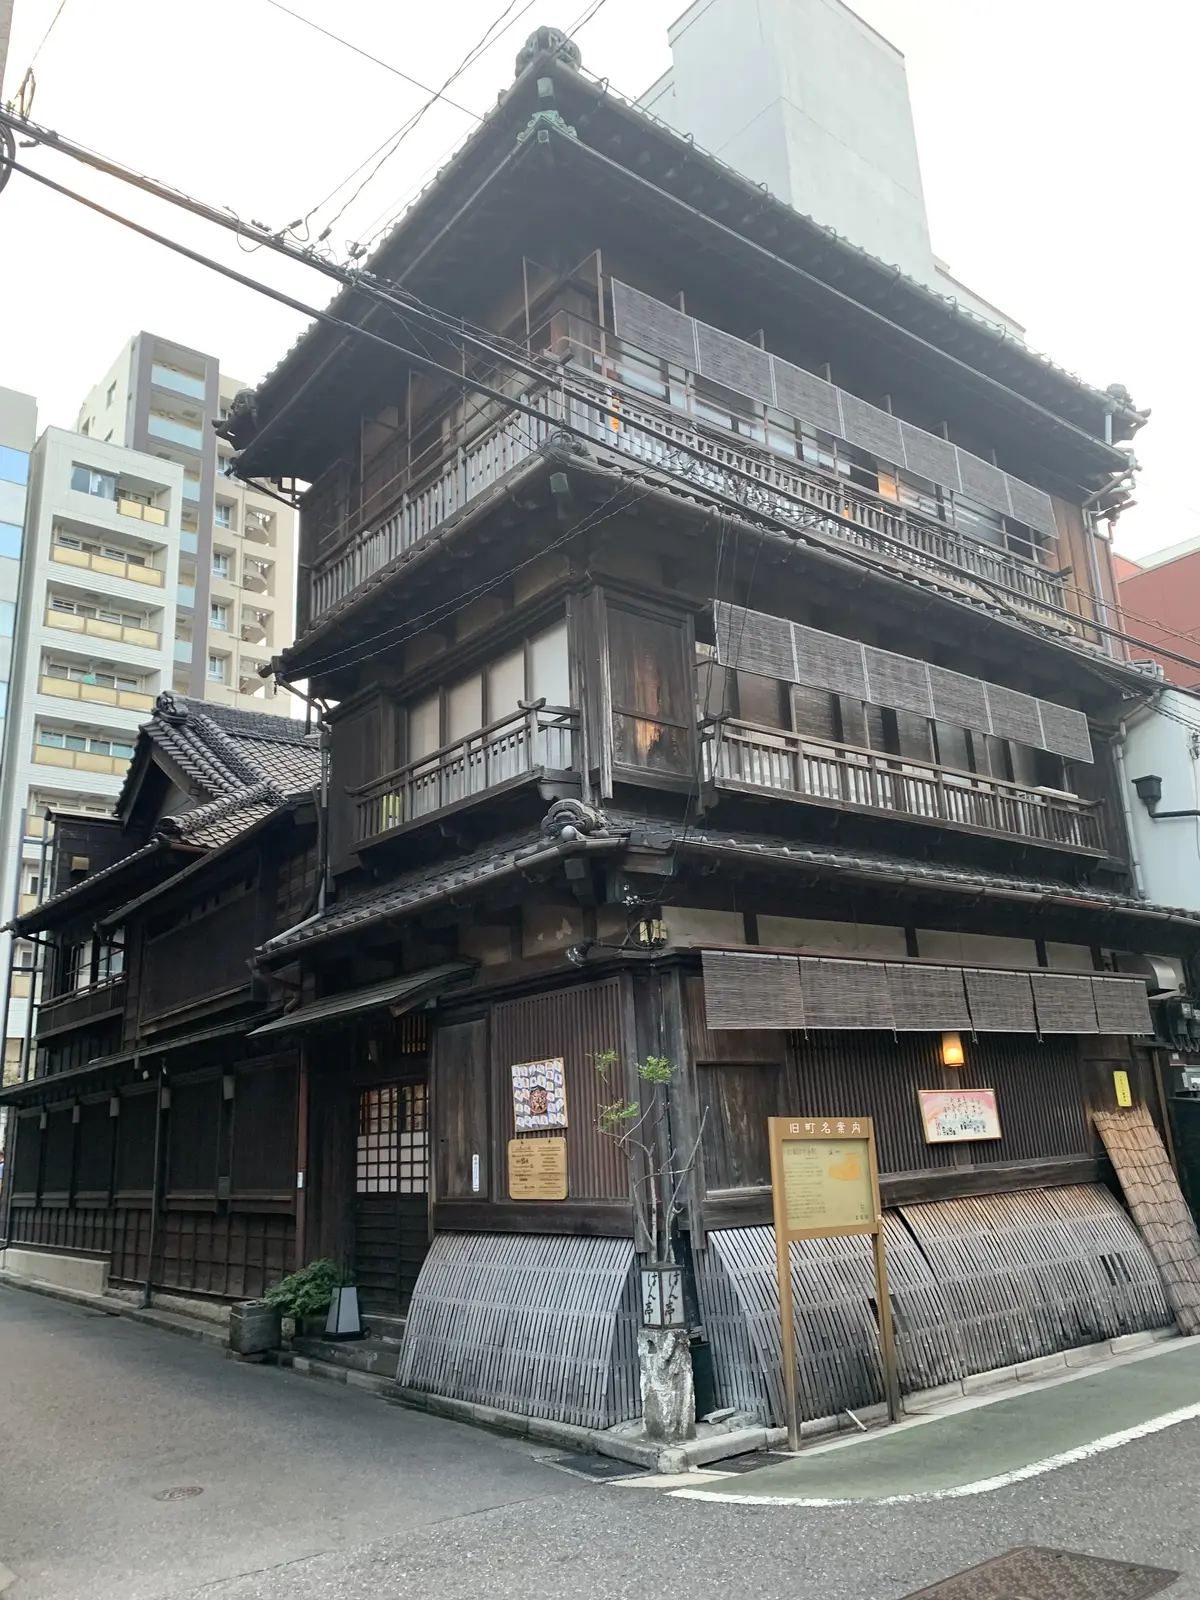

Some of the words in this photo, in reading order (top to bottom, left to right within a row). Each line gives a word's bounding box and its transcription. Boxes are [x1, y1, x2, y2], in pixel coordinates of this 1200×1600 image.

[789, 1121, 861, 1134] 旧町名案内
[644, 1272, 658, 1323] はん亭
[665, 1270, 680, 1324] はん亭
